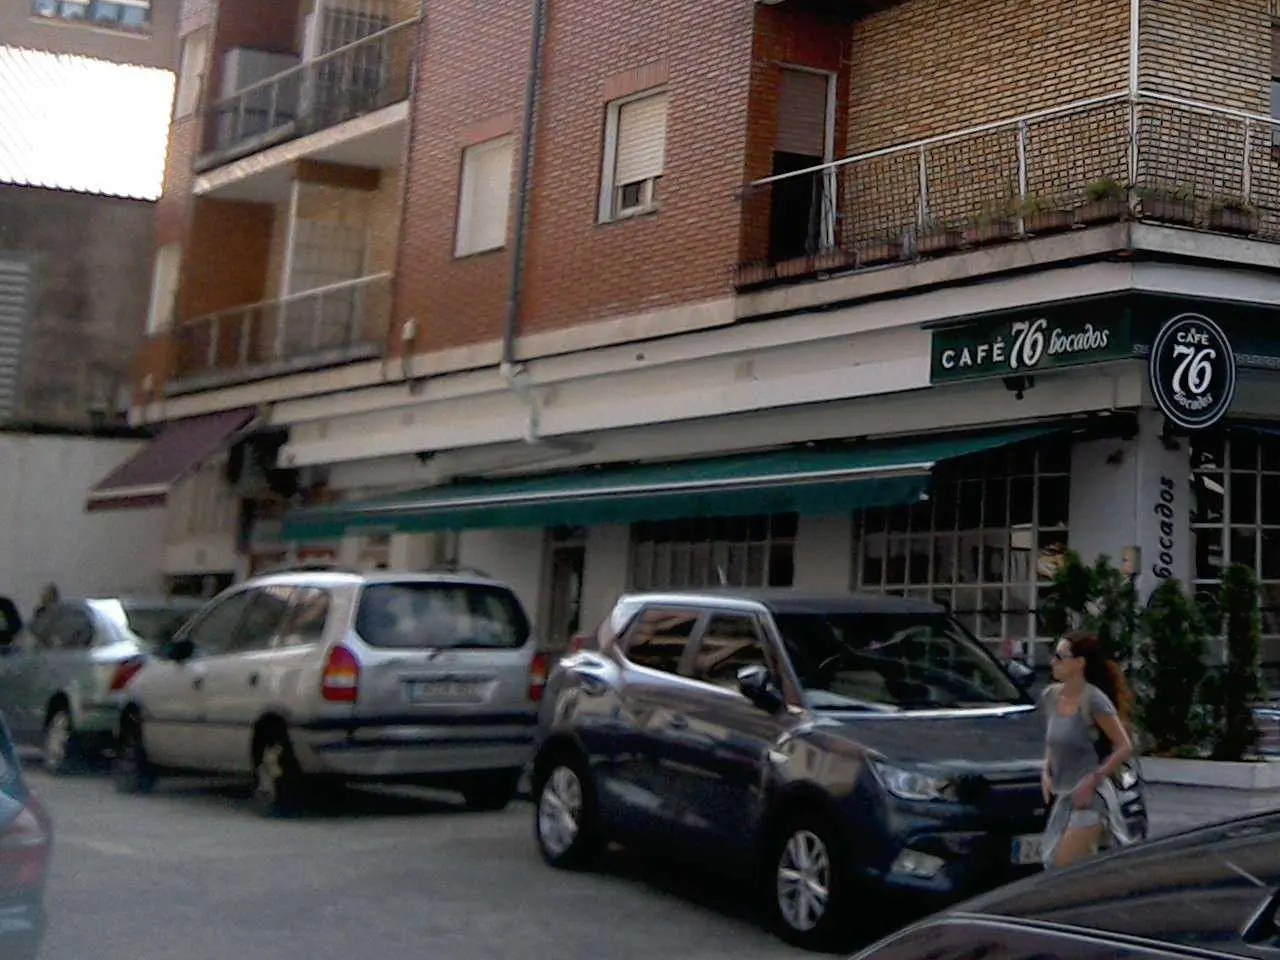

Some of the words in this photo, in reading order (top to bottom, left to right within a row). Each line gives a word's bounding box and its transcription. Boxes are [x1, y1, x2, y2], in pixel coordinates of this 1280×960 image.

[941, 336, 1005, 369] CAFÉ
[1010, 318, 1047, 369] 76
[1048, 323, 1110, 355] bocados
[1177, 329, 1210, 345] CAFÉ
[1172, 343, 1217, 394] 76
[1152, 476, 1175, 579] bocados
